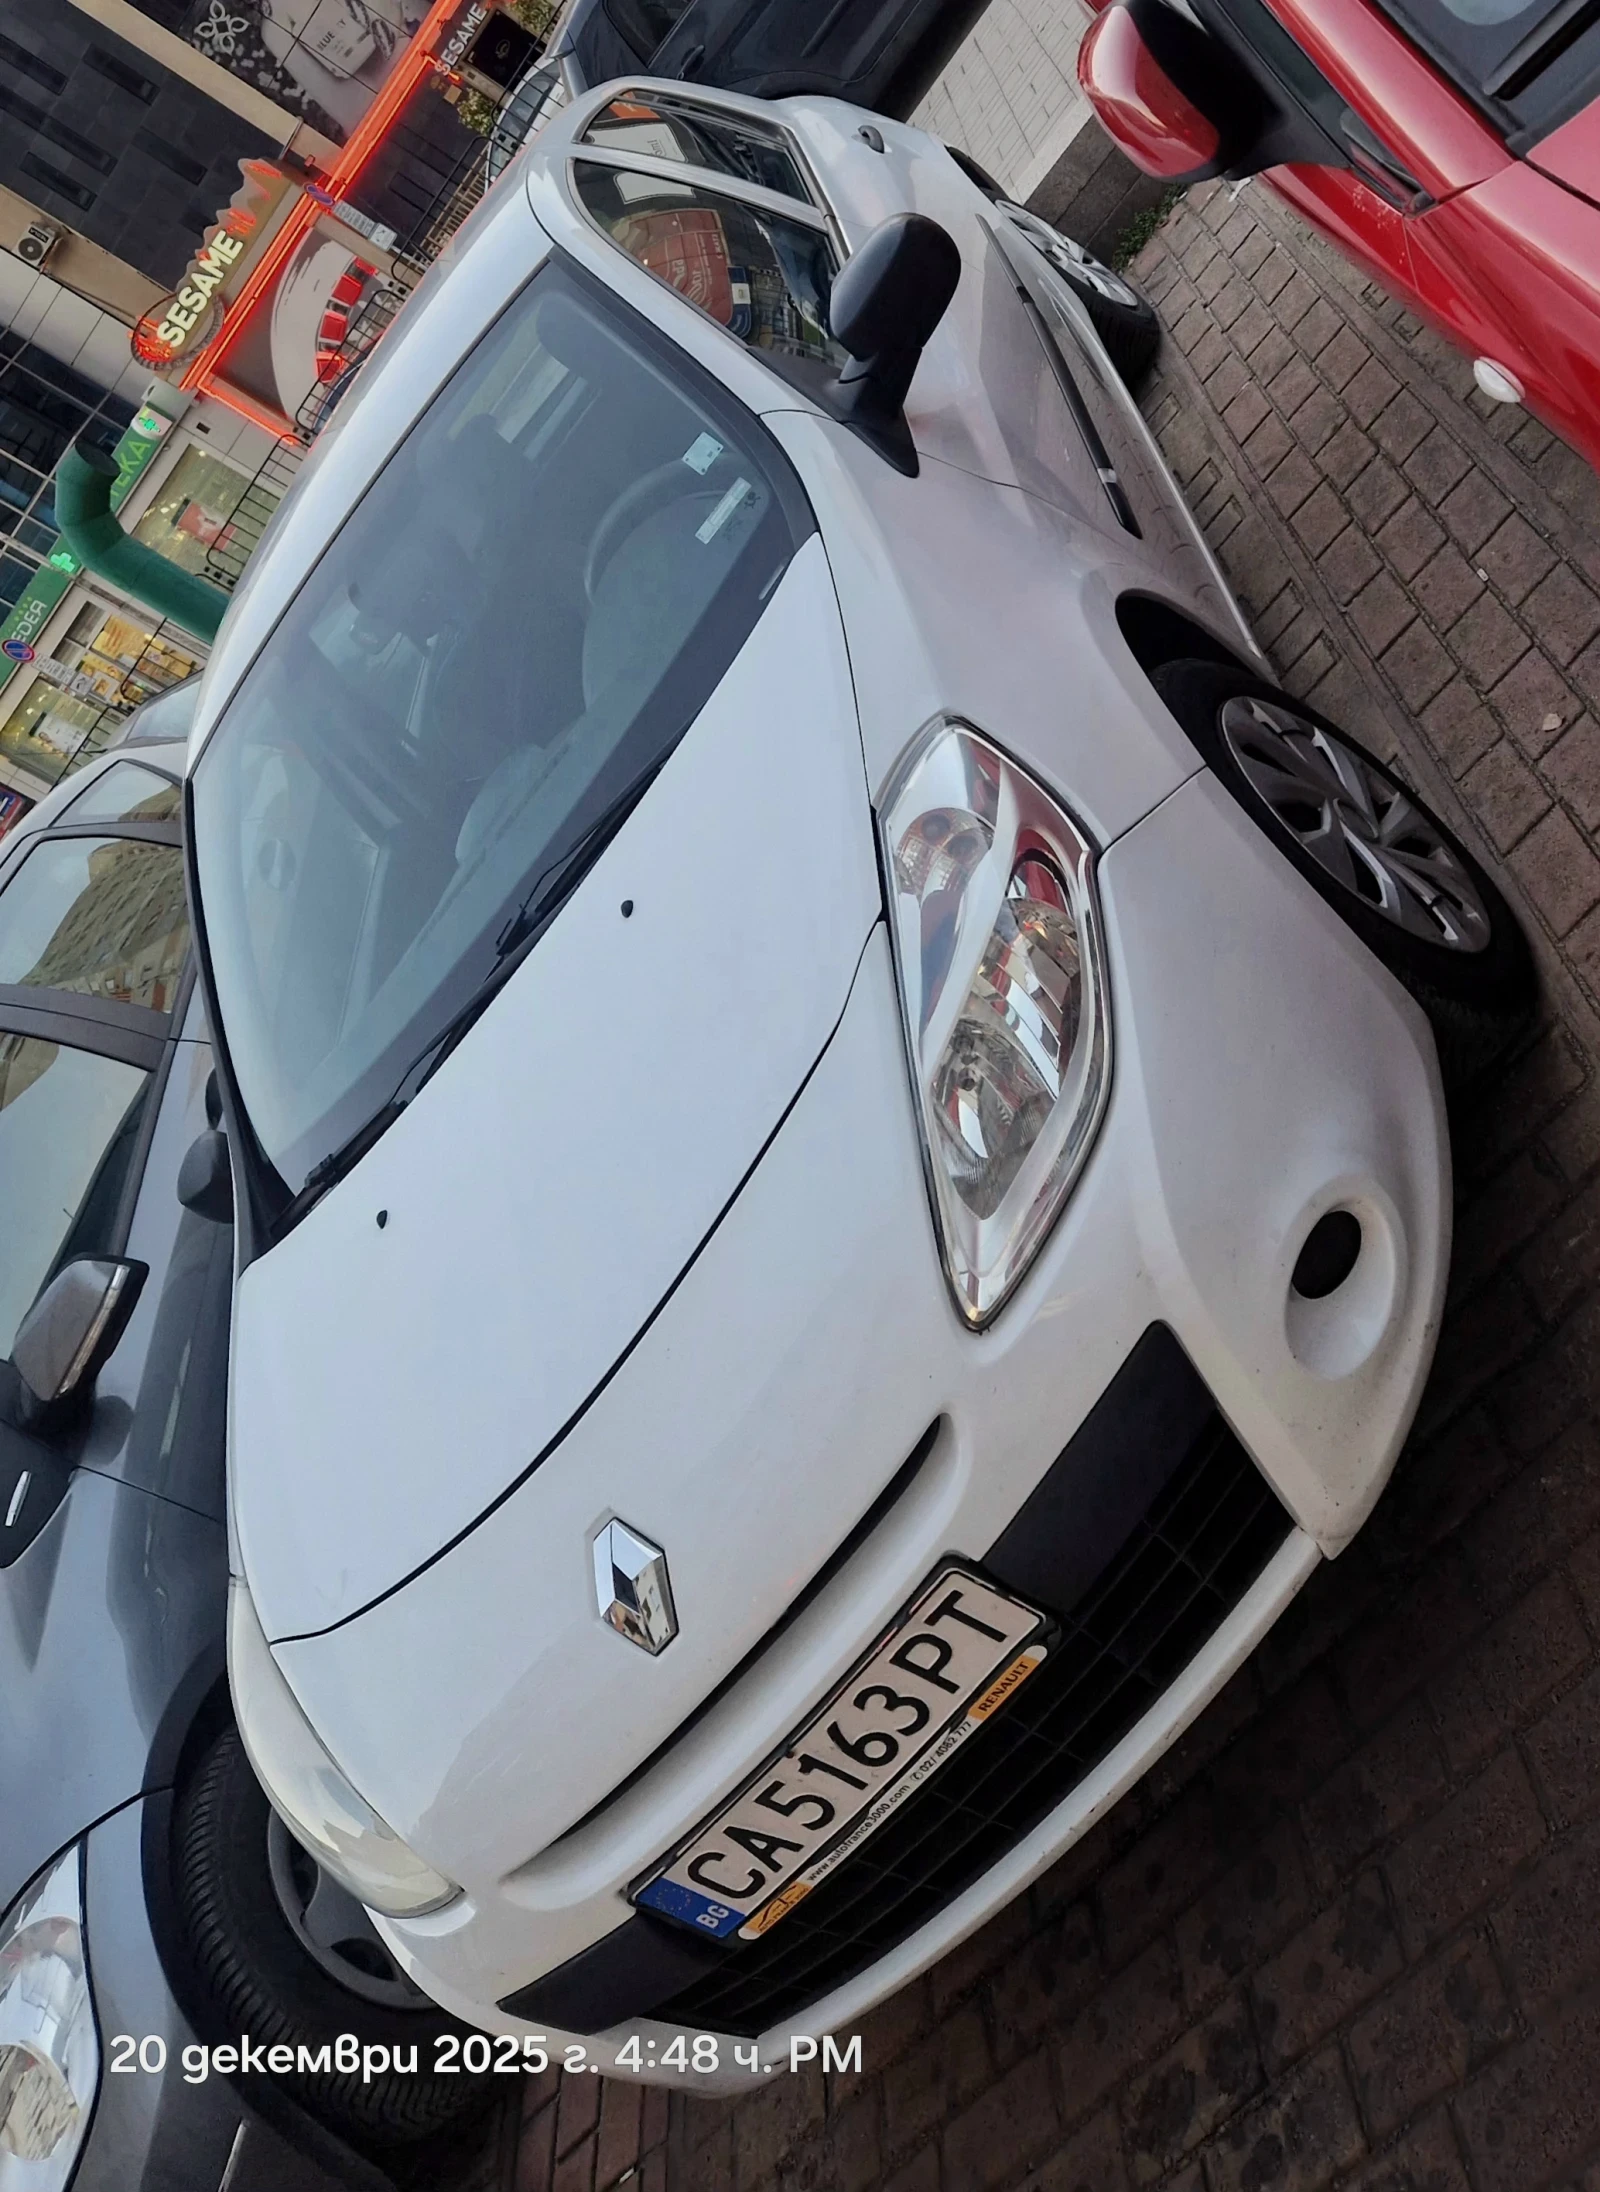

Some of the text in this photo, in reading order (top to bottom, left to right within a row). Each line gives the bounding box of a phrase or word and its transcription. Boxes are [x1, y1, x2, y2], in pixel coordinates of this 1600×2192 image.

[435, 3, 487, 76] SESAME
[157, 230, 244, 347] SESAME
[978, 1661, 1029, 1713] RENAULT
[807, 1784, 911, 1882] www.autofrance3000.com
[956, 1720, 972, 1737] 777
[696, 1905, 728, 1928] BG
